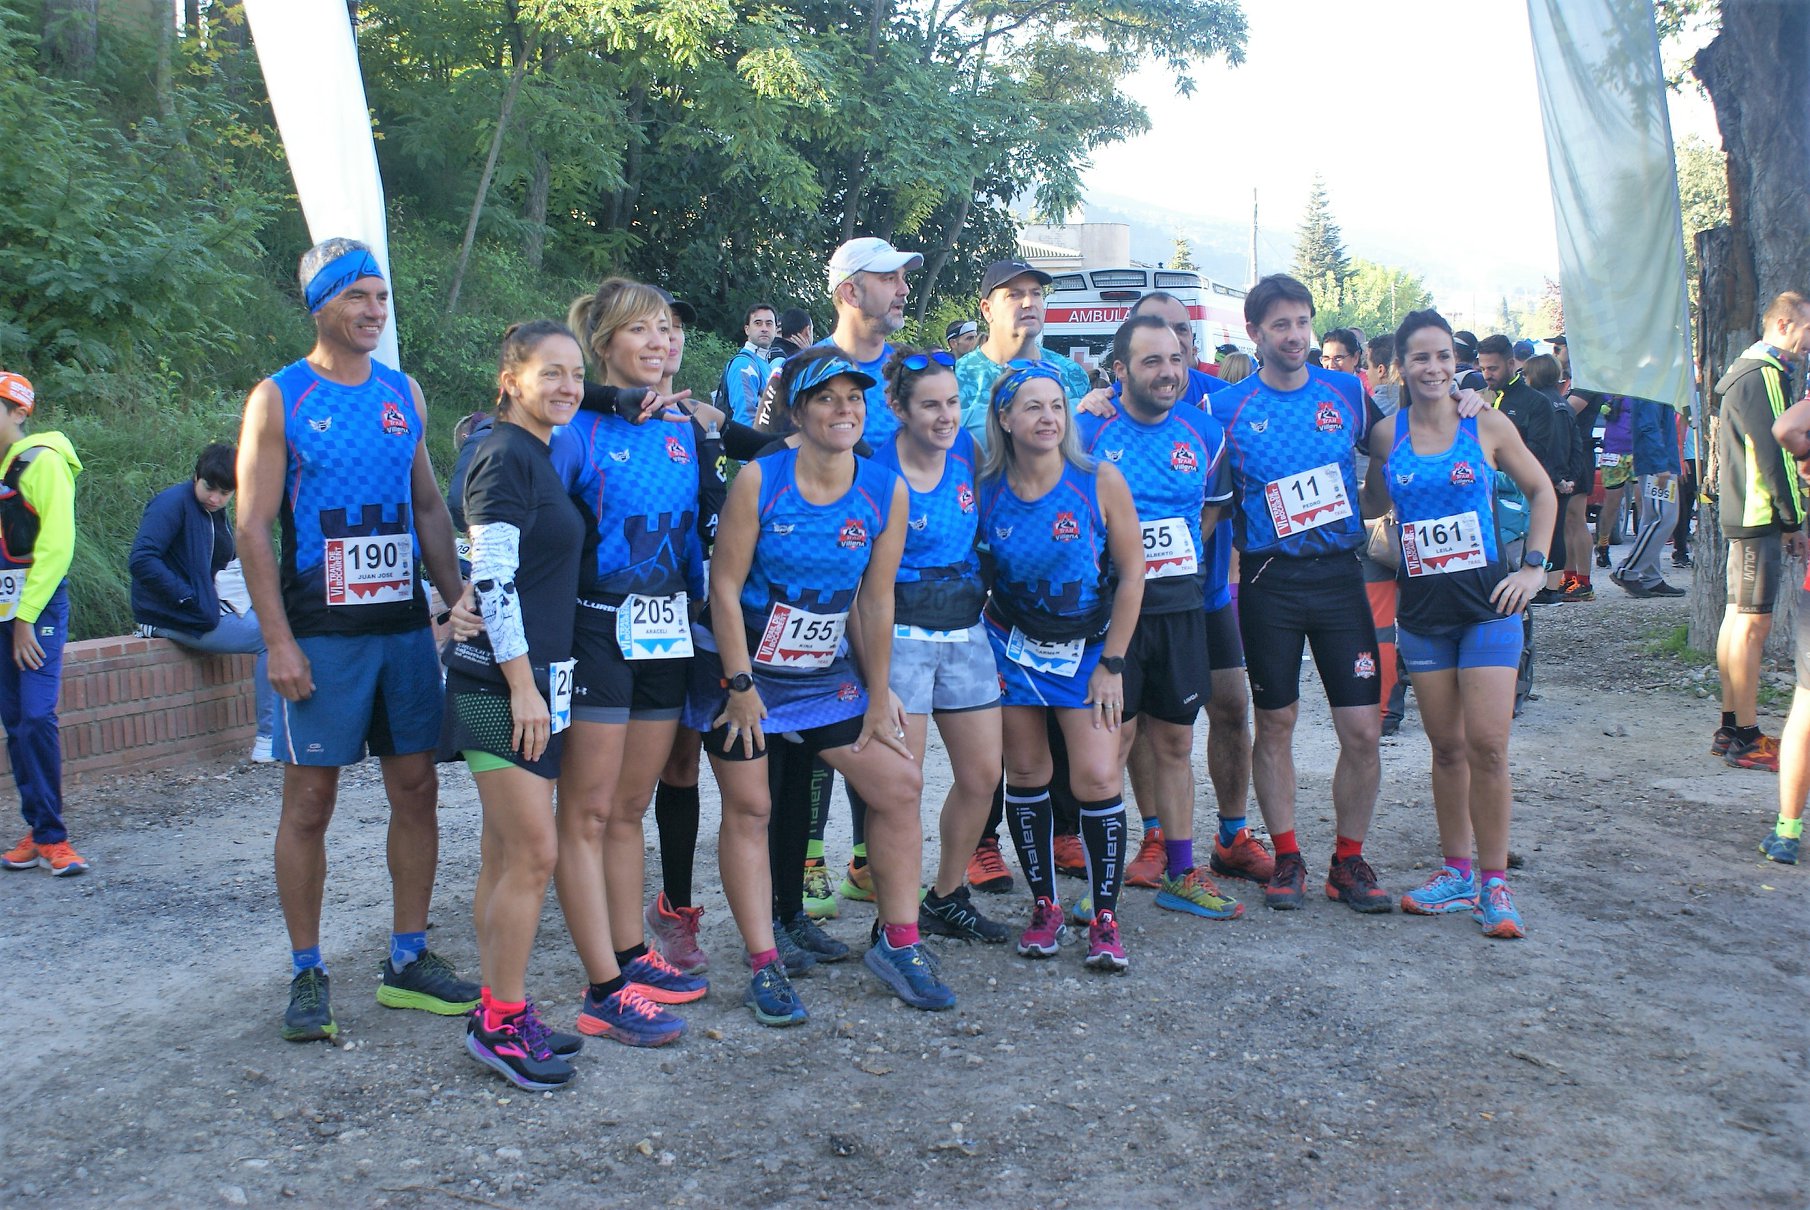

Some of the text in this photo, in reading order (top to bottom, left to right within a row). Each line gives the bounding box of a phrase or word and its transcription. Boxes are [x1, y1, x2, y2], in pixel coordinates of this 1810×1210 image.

[1292, 476, 1319, 501] 11
[1302, 500, 1321, 509] PEDRO
[1276, 519, 1289, 530] VI
[1418, 521, 1462, 547] 161
[335, 547, 344, 586] BOCAIRENT
[348, 542, 398, 570] 190
[1408, 561, 1420, 570] VI
[330, 585, 344, 597] VI
[633, 597, 675, 624] 205
[791, 617, 835, 641] 155
[760, 646, 774, 656] VI
[1016, 806, 1043, 882] Kalenji
[1100, 817, 1122, 897] Kalenji
